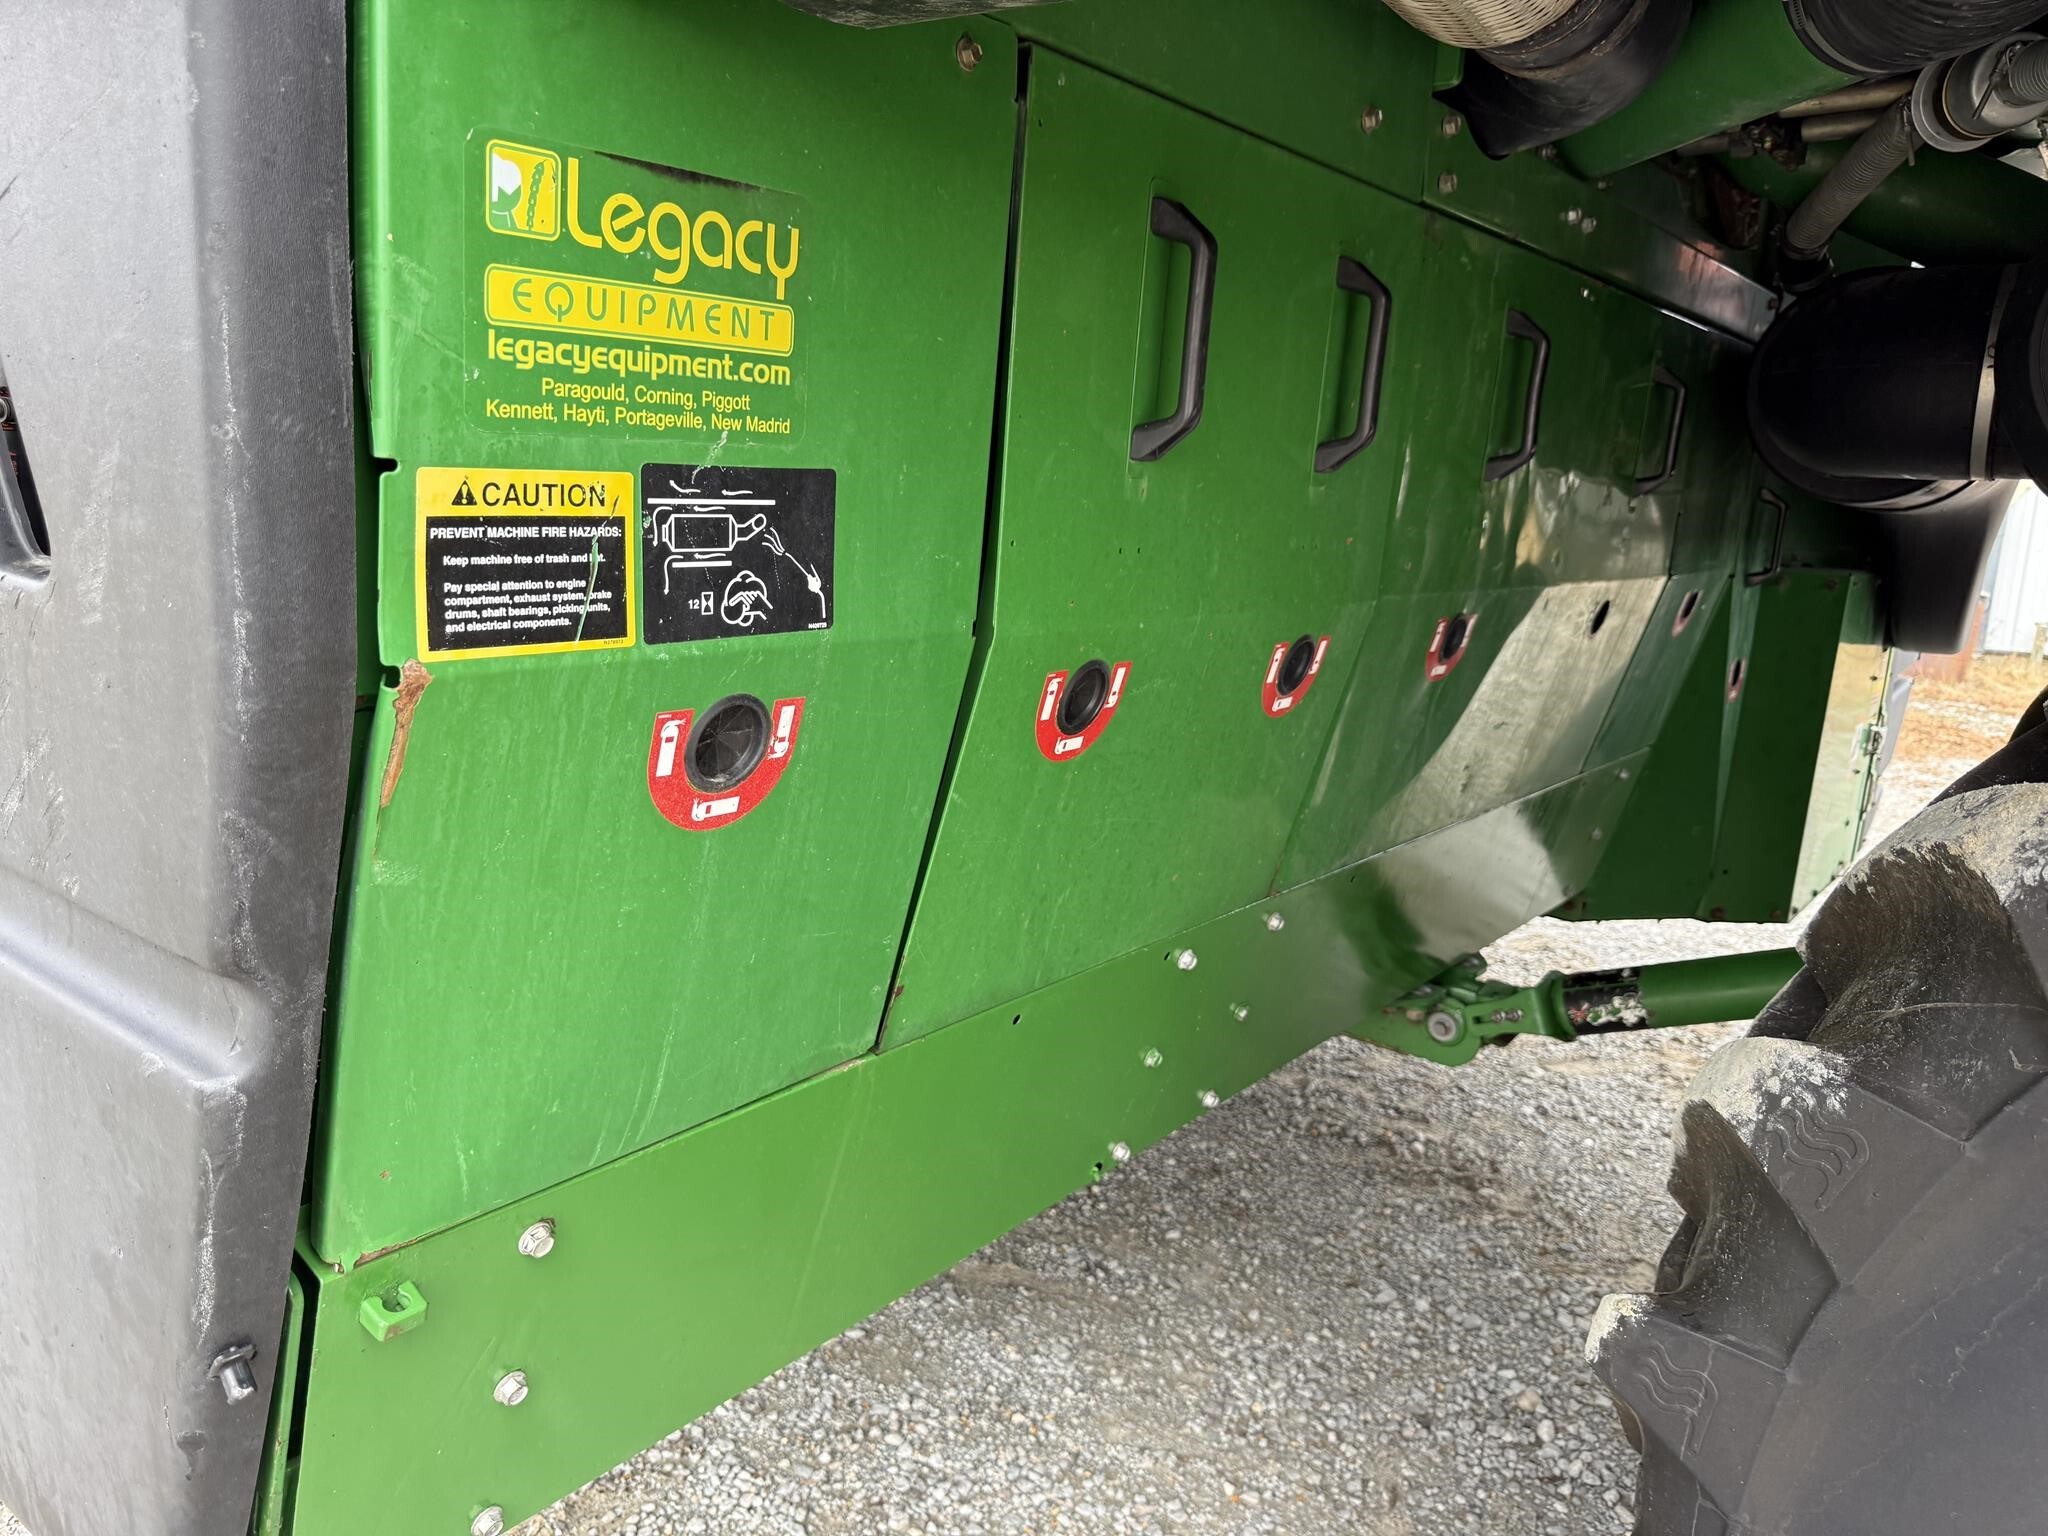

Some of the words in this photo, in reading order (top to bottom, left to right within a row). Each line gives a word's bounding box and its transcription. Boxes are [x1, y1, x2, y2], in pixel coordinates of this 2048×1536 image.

[567, 157, 800, 301] Legacy
[512, 278, 775, 342] EQUIPMENT
[487, 328, 791, 387] legacyequipment.com
[541, 377, 630, 404] Paragould,
[634, 385, 697, 410] Corning,
[702, 390, 751, 413] Piggott
[486, 398, 558, 424] Kennett,
[563, 403, 610, 427] Hayti,
[615, 406, 707, 431] Portageville,
[711, 413, 743, 432] New
[746, 416, 791, 434] Madrid
[482, 482, 606, 508] CAUTION
[430, 526, 485, 540] PREVENT
[486, 526, 540, 539] MACHINE
[541, 526, 567, 538] FIRE
[569, 526, 622, 538] HAZARDS:
[443, 555, 470, 568] Keep
[470, 554, 513, 565] machine
[513, 553, 534, 565] free
[534, 553, 545, 564] of
[545, 552, 570, 564] trash
[571, 552, 588, 563] and
[443, 582, 463, 595] Pay
[464, 580, 500, 595] special
[501, 580, 544, 591] attention
[544, 579, 555, 589] to
[556, 578, 587, 590] engine
[444, 594, 513, 608] compartment,
[513, 592, 551, 603] exhaust
[552, 591, 587, 604] system,
[688, 599, 700, 610] 12
[444, 609, 481, 620] drums,
[481, 606, 508, 618] shaft
[508, 605, 552, 617] bearings,
[552, 603, 585, 616] picking
[587, 601, 611, 612] units,
[445, 621, 466, 633] and
[466, 619, 512, 632] electrical
[512, 616, 573, 630] components.
